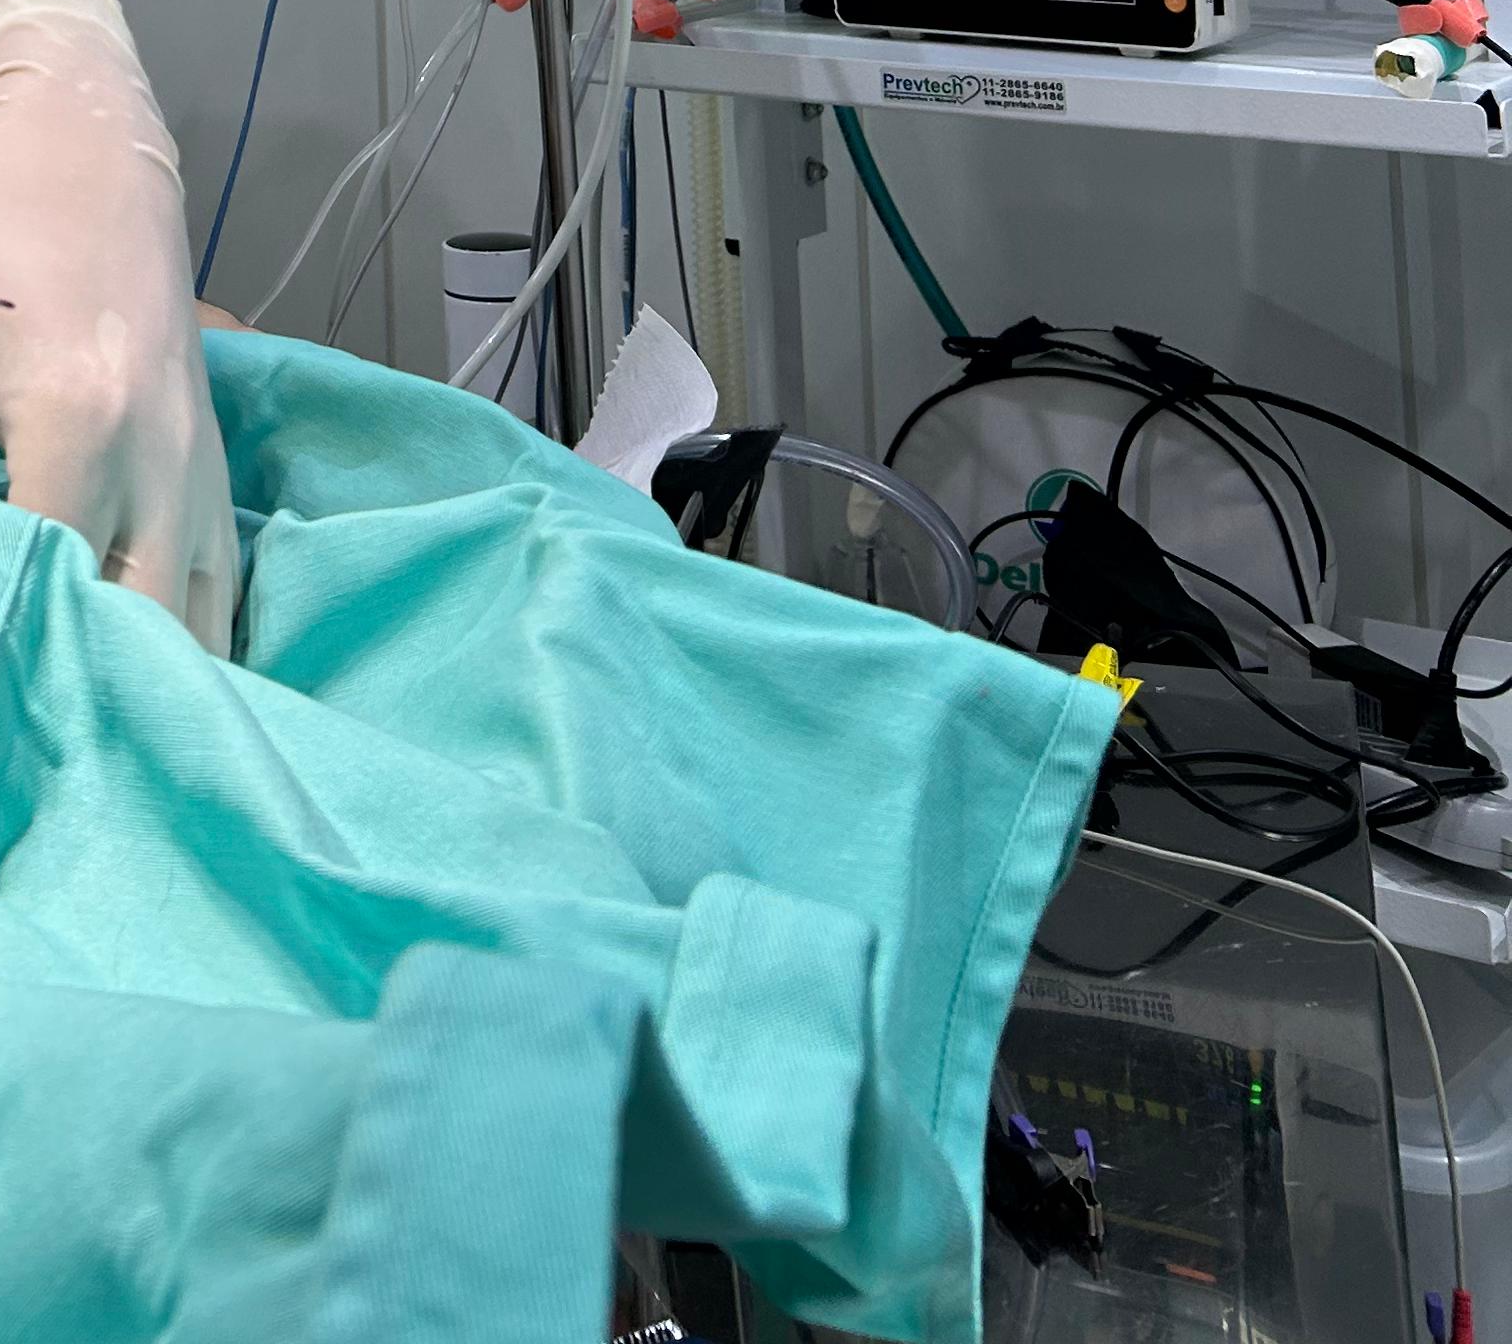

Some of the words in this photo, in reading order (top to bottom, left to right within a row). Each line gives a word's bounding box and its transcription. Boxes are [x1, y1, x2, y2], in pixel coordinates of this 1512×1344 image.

[883, 73, 964, 95] Prevtech
[982, 78, 1064, 92] 11-2865-6640
[982, 87, 1065, 102] 11-2865-9186
[972, 553, 1041, 592] Del
